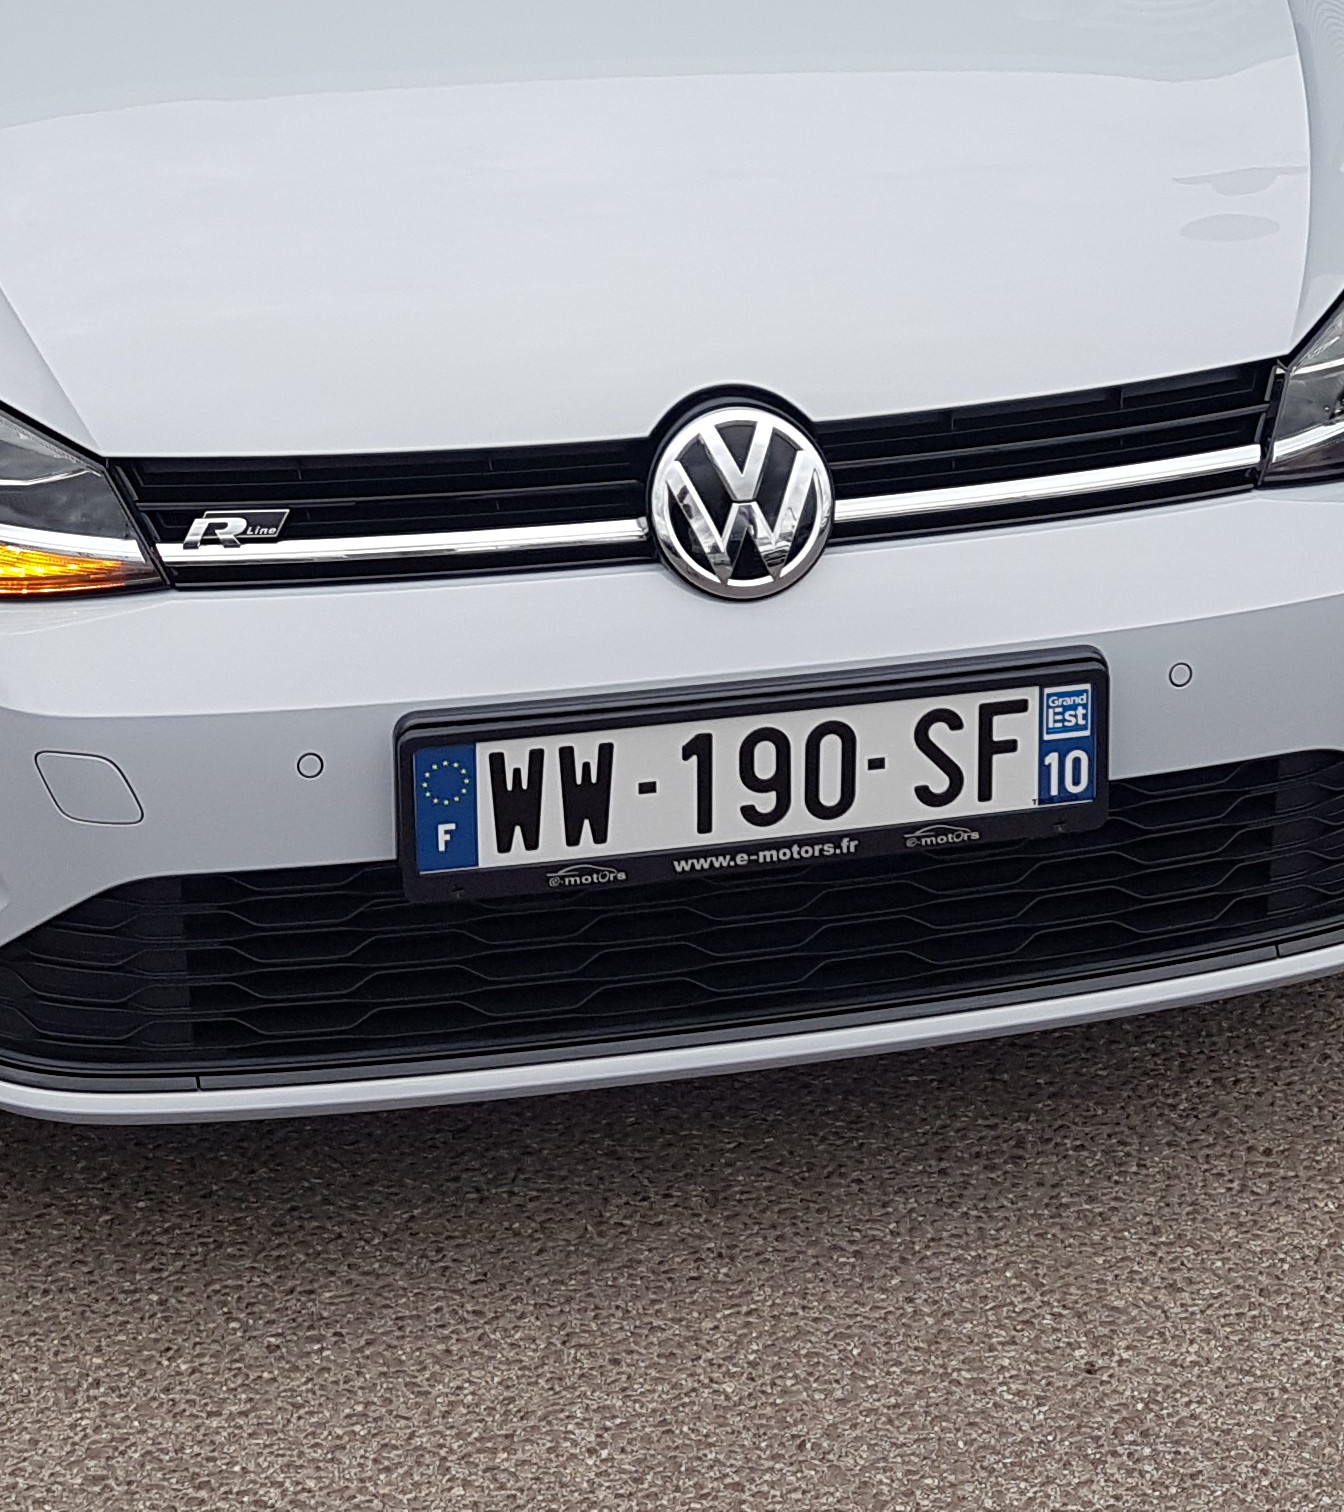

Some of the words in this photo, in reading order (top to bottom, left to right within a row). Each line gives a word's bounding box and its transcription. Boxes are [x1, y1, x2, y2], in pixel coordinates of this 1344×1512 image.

[183, 517, 248, 550] R
[1048, 693, 1087, 707] Grand
[1048, 705, 1087, 728] Est
[488, 697, 1029, 854] WW-190-SF
[1044, 749, 1089, 796] 10
[438, 823, 456, 852] F
[672, 837, 859, 873] www.e-motors.fr
